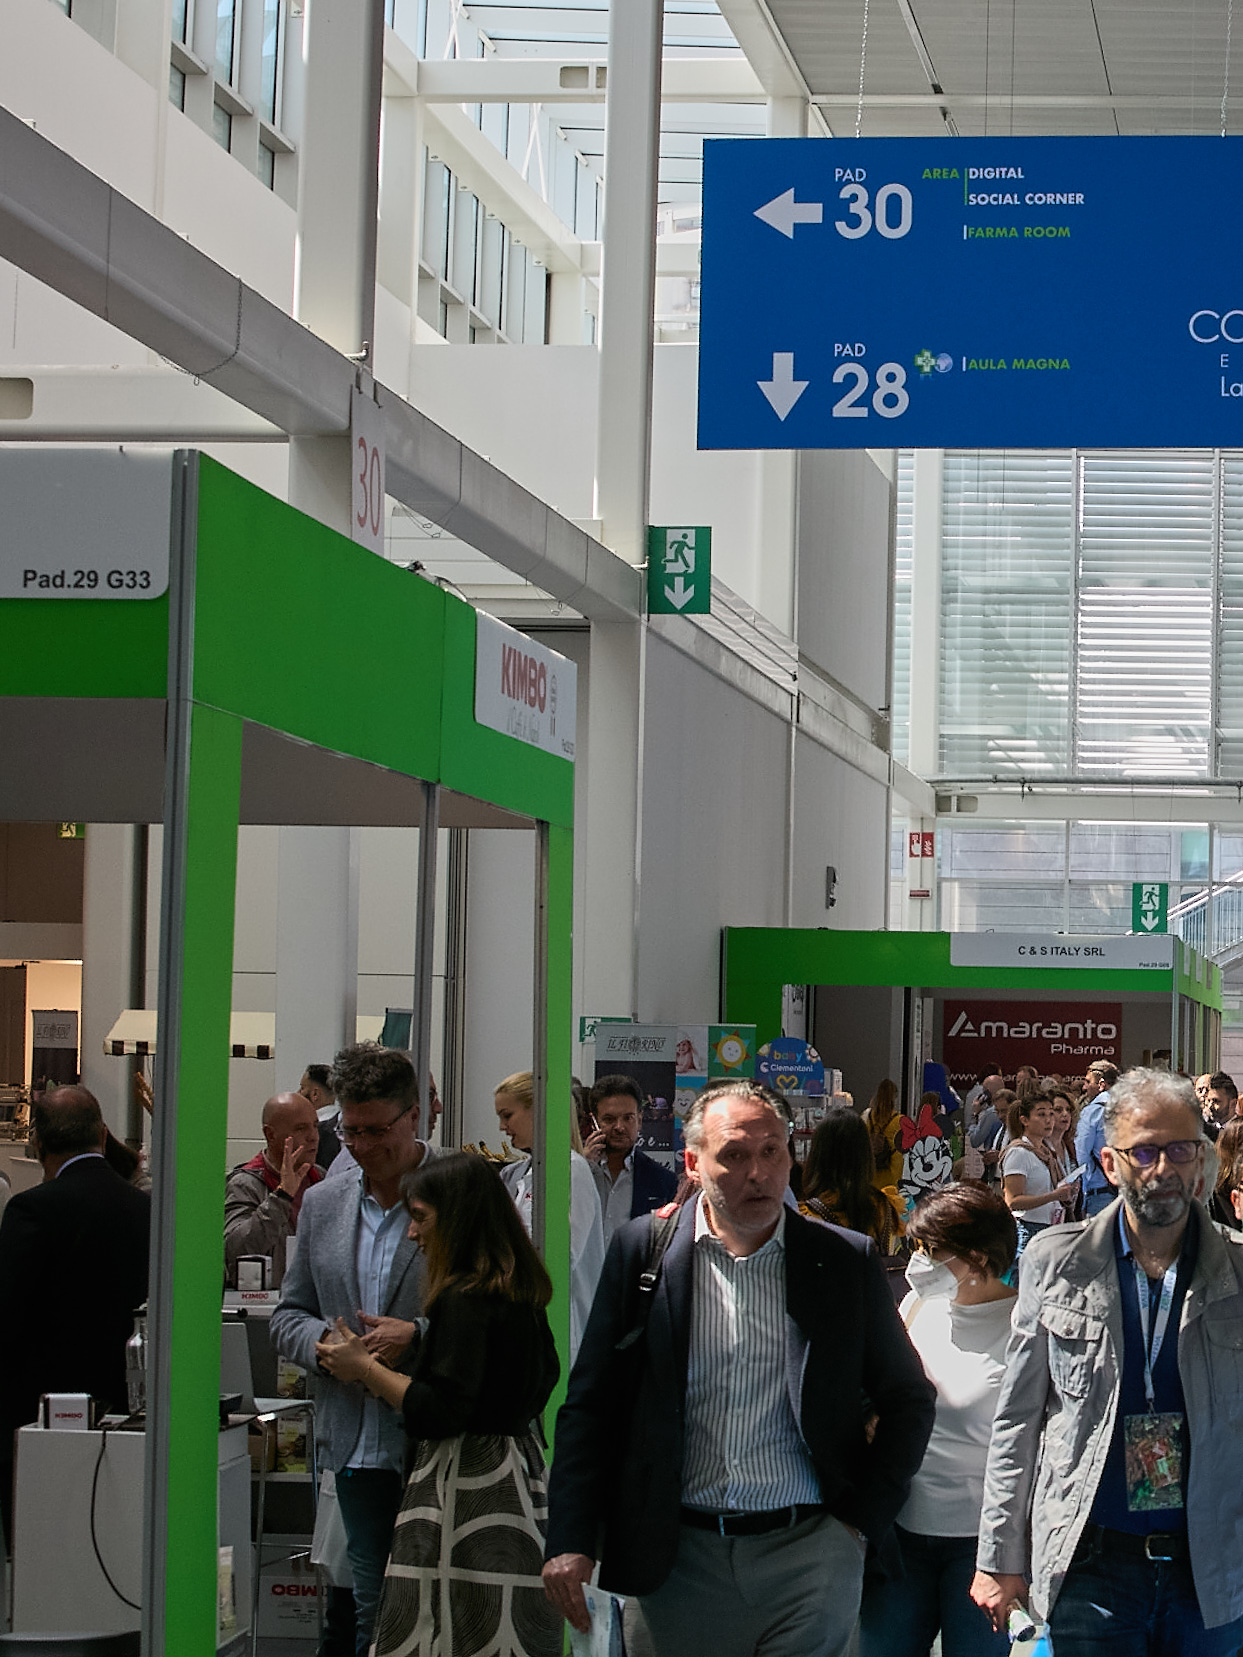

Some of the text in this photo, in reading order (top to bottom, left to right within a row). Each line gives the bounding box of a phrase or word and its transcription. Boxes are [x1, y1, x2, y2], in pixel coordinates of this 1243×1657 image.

[835, 168, 866, 182] PAD
[922, 167, 1024, 179] AREA DIGITAL
[969, 193, 1084, 205] SOCIAL CORNER
[834, 183, 913, 239] 30
[969, 227, 1071, 238] FARMA ROOM
[834, 343, 866, 357] PAD
[968, 358, 1070, 371] AULA MAGNA
[832, 362, 910, 418] 28
[1221, 375, 1243, 397] La
[357, 436, 381, 536] 30
[23, 570, 151, 589] Pad.29 G33
[501, 642, 547, 714] KIMBO
[1018, 946, 1106, 957] C & S ITALY SRL
[948, 1010, 1117, 1040] Amaranto
[1050, 1043, 1115, 1056] Pharma
[771, 1064, 813, 1073] Clementoni
